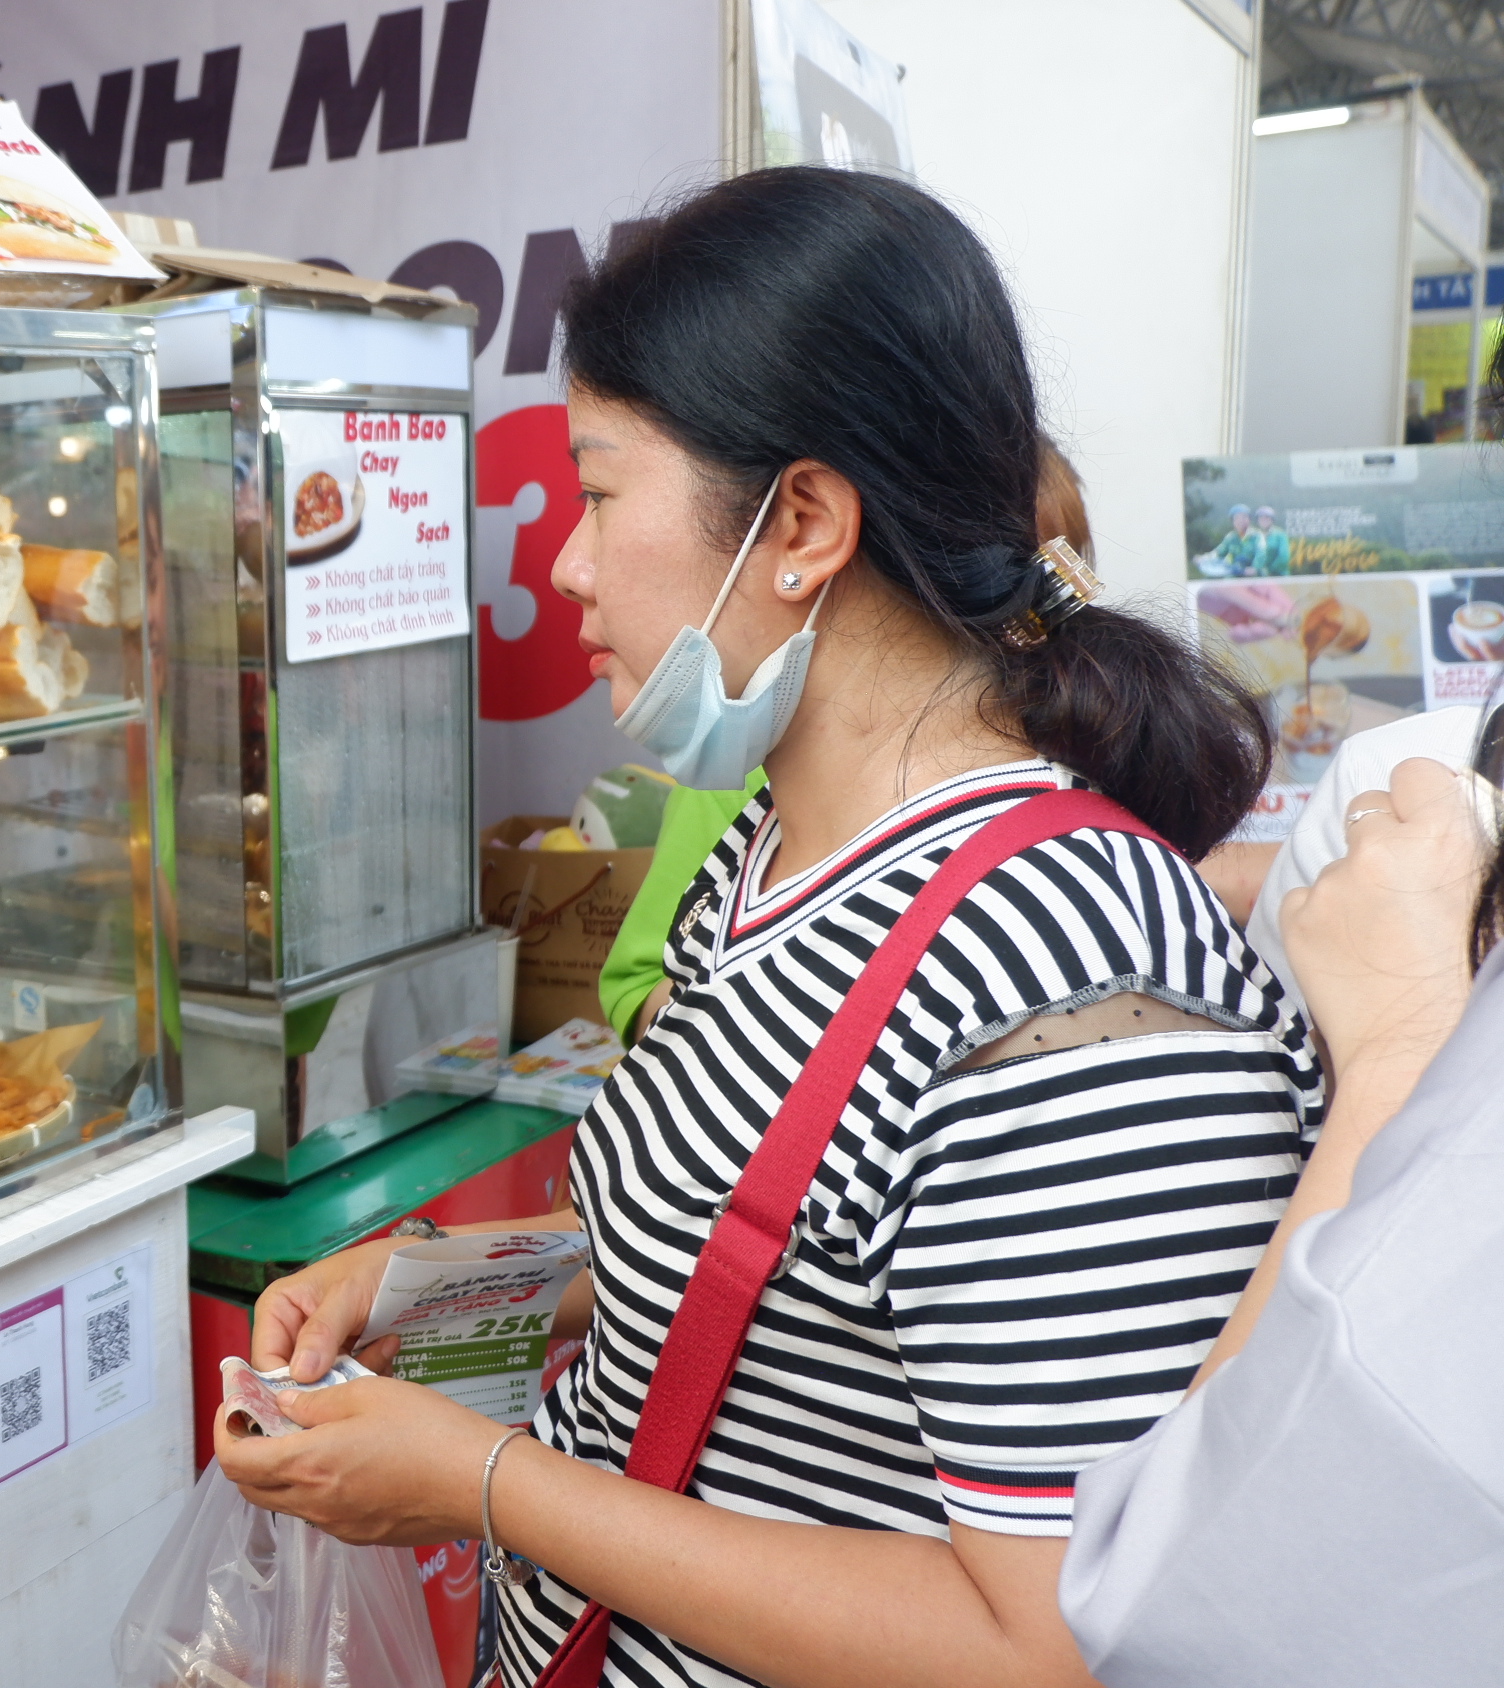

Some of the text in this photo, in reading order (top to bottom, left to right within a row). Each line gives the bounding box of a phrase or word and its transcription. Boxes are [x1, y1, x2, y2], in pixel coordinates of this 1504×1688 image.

[344, 411, 446, 442] Bánh Bao
[360, 451, 399, 476] Chay
[388, 487, 428, 513] Ngon
[416, 521, 450, 549] Sạch
[413, 1287, 476, 1307] CHAY
[480, 1276, 555, 1292] NGON
[508, 1284, 543, 1303] 3
[467, 1311, 553, 1339] 25K
[508, 1342, 531, 1351] 50K
[506, 1355, 528, 1365] 50K
